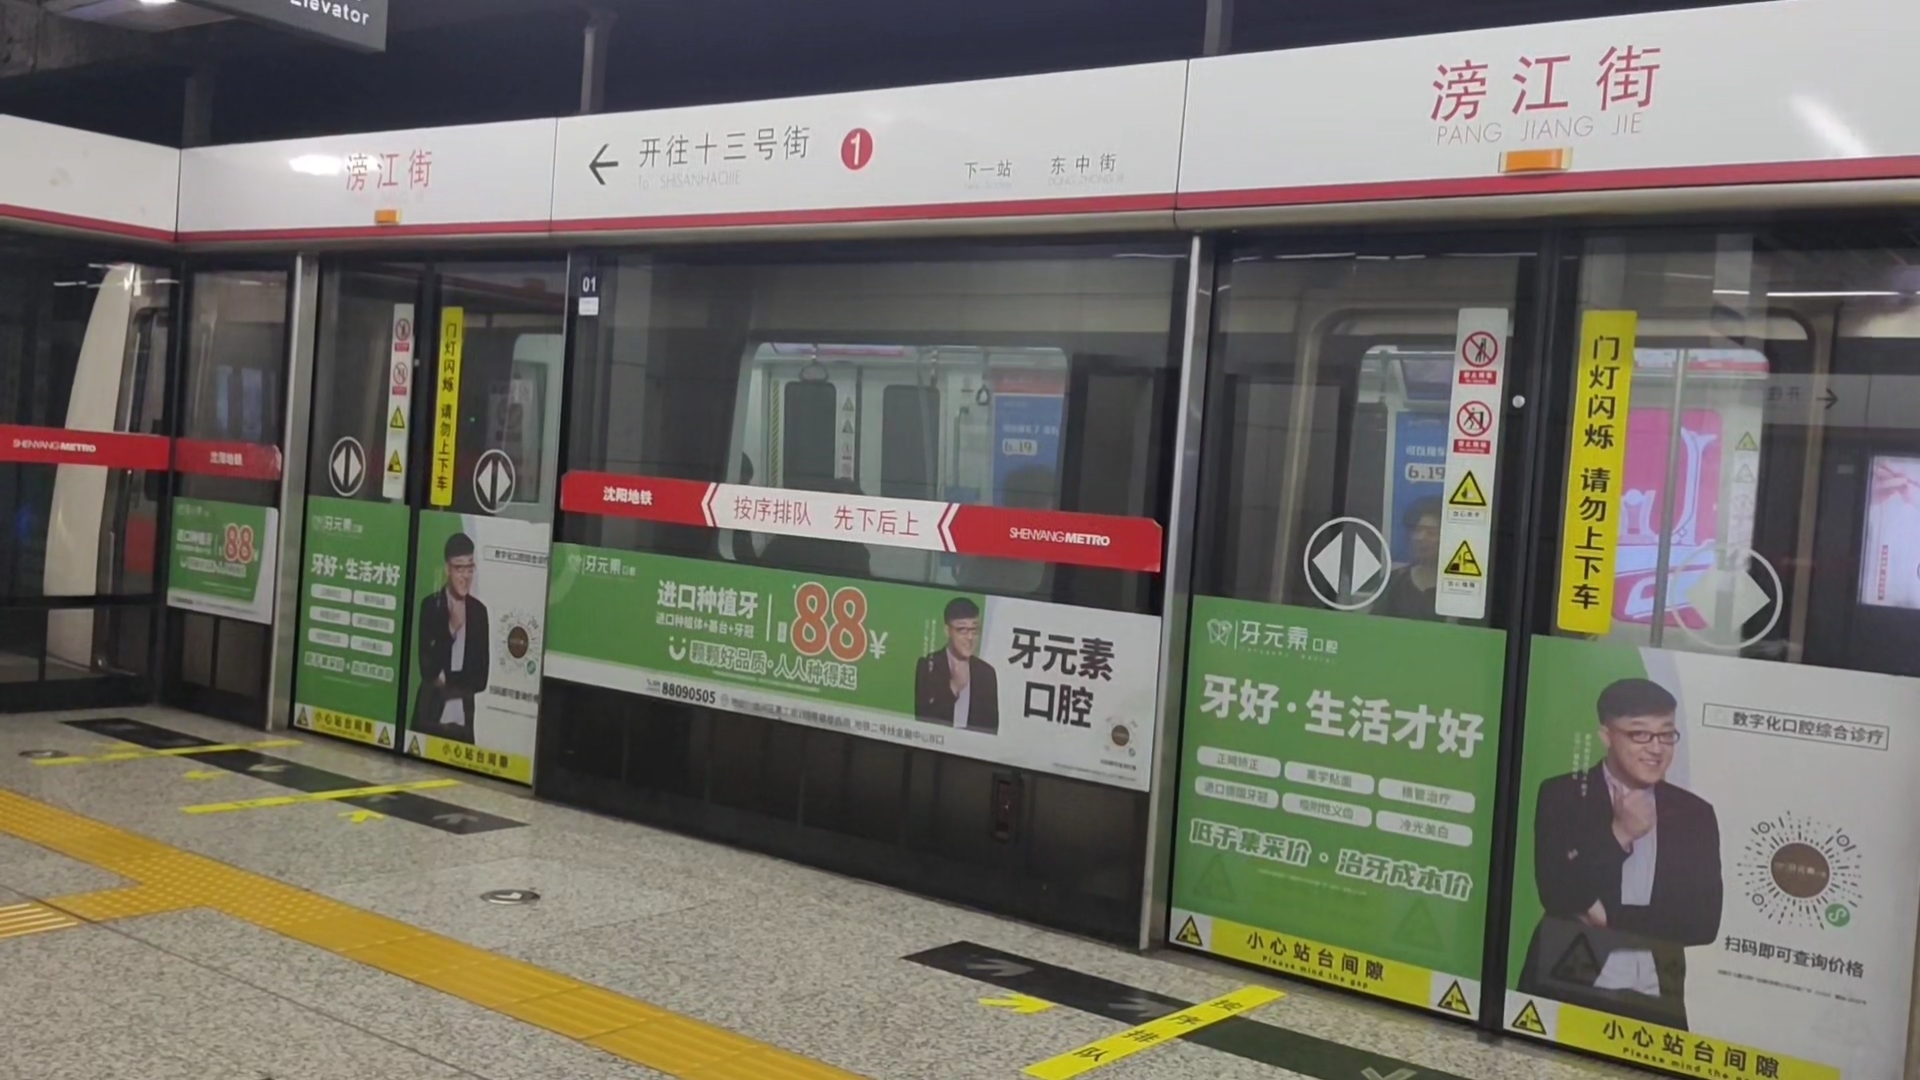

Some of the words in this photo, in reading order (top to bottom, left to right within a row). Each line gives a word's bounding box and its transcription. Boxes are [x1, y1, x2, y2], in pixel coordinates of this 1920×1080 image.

[1430, 45, 1661, 121] 滂江街
[638, 125, 810, 169] 开往十三号街
[849, 133, 862, 167] 1
[1436, 122, 1503, 146] PANG
[1520, 115, 1594, 142] JIANG
[1612, 112, 1643, 136] JIE
[346, 149, 433, 191] 滂江街
[963, 159, 1012, 180] 下一站
[1050, 152, 1118, 176] 东中街
[582, 275, 597, 293] 01
[441, 322, 457, 392] 门灯闪烁
[1583, 335, 1621, 449] 门灯闪烁
[436, 403, 453, 491] 请勿上下车
[602, 485, 653, 506] 沈阳地铁
[734, 495, 812, 526] 按序排队
[833, 504, 921, 537] 先下后上
[1009, 526, 1111, 547] SHENYANGMETRO
[1571, 467, 1612, 610] 请勿上下车
[656, 579, 759, 620] 进口种植牙
[1008, 627, 1115, 682] 牙元素
[661, 681, 717, 705] 88090505
[1023, 680, 1094, 729] 口腔
[1199, 673, 1485, 760] 牙好·生活才好
[1733, 711, 1885, 747] 数字化口腔综合诊疗
[1399, 818, 1450, 840] 冷光美白
[1246, 931, 1385, 983] 小心站台间隙
[1724, 935, 1865, 979] 扫码即可查询价格
[1072, 998, 1245, 1064] 按序排队
[1603, 1018, 1780, 1079] 小心站台间隙
